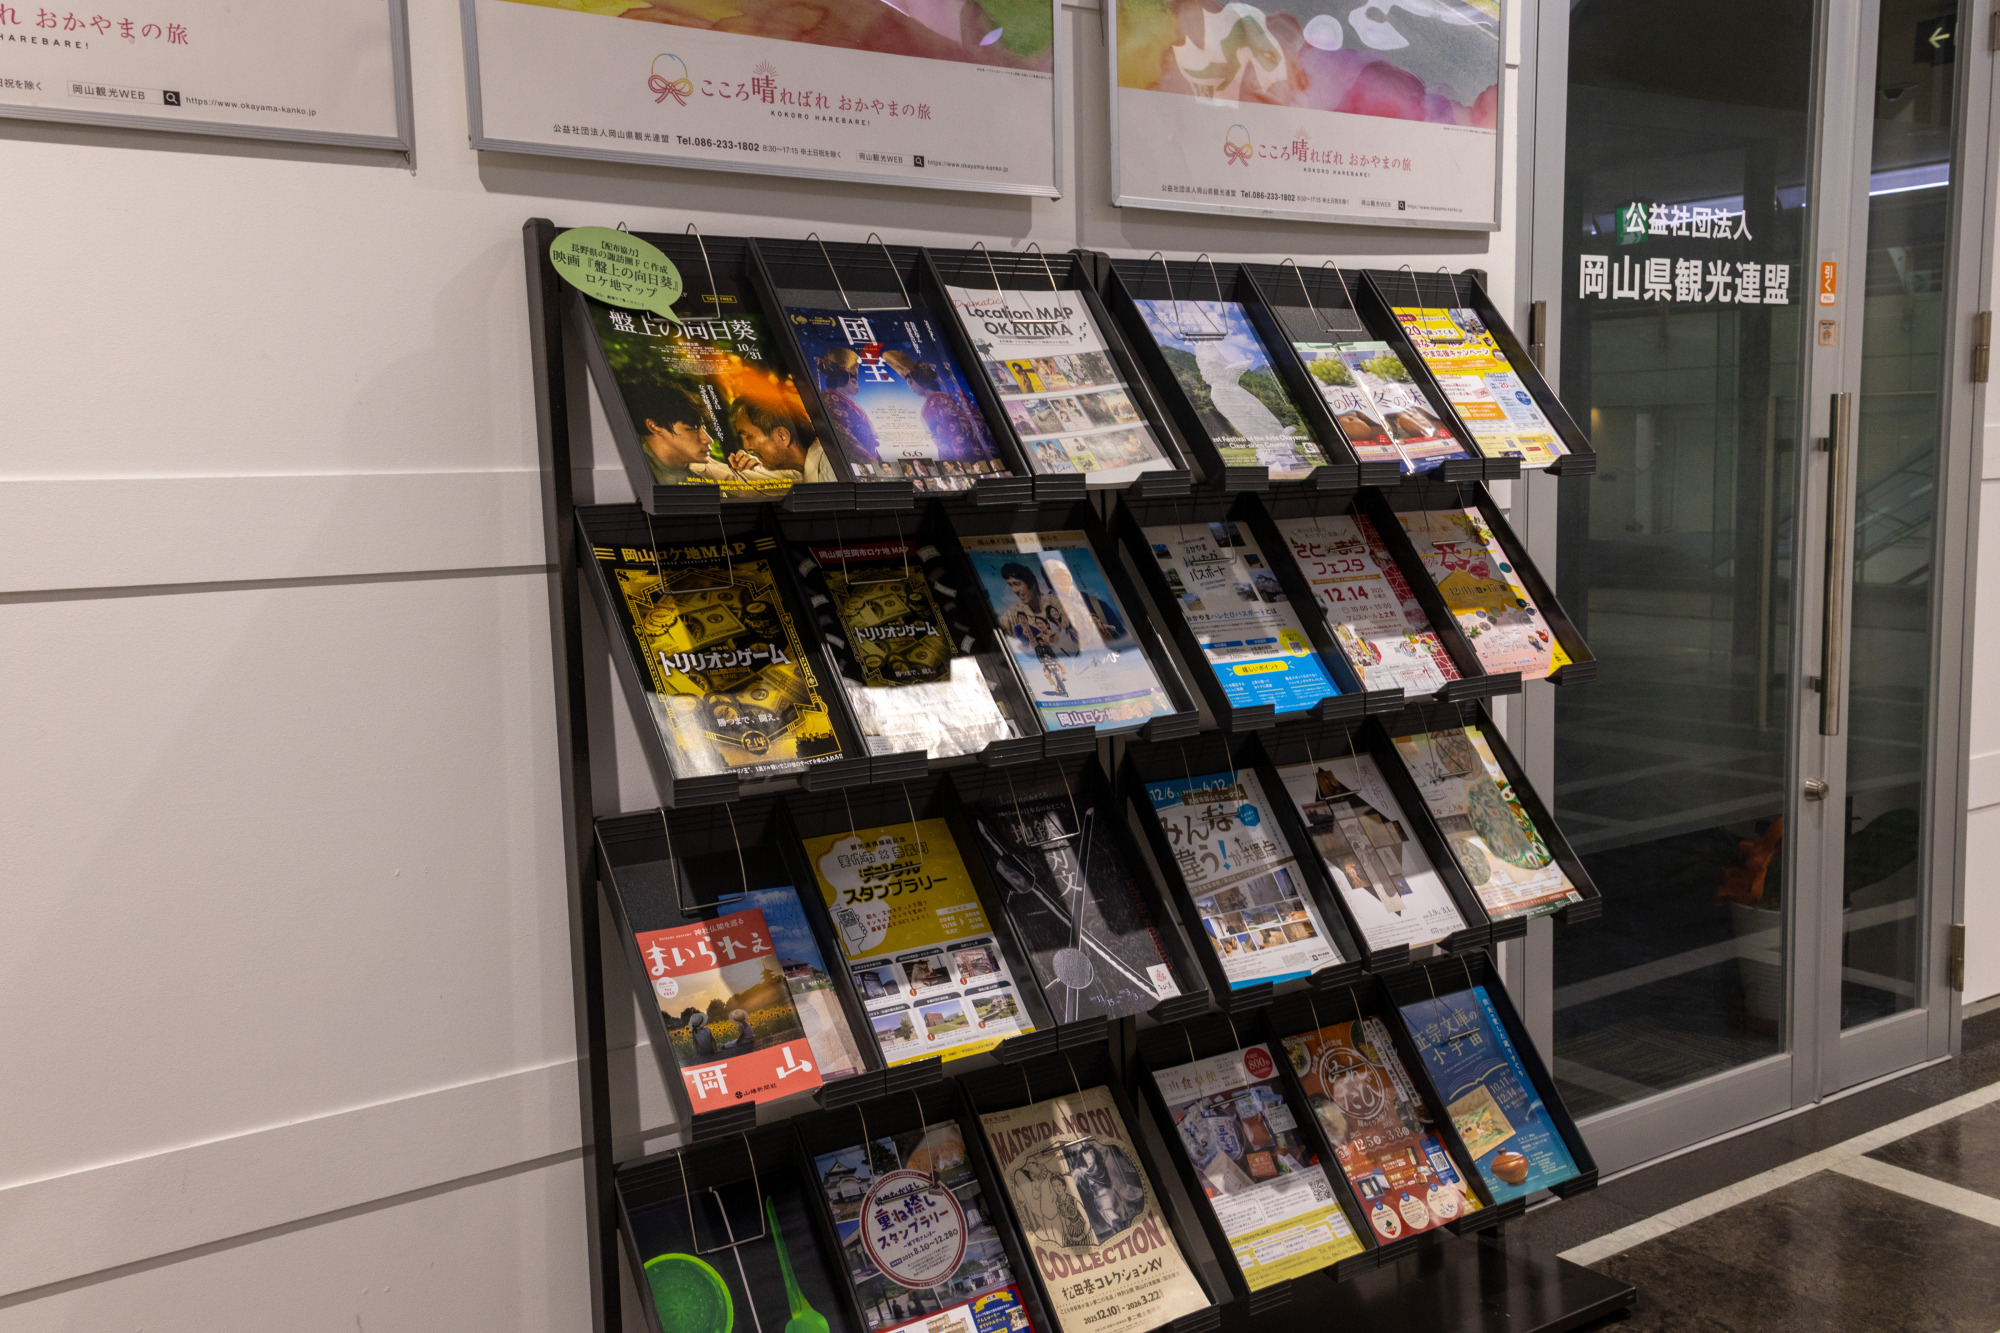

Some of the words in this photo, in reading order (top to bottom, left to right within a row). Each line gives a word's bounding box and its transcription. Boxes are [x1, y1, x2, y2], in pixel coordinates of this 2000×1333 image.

[35, 7, 189, 45] おかやまの旅
[72, 84, 146, 101] 岡山観光WEB
[186, 96, 317, 118] https://www.okayama-kanko.jp
[701, 75, 830, 109] こころ晴ればれ
[839, 95, 931, 120] おかやまの旅
[771, 110, 809, 120] KOKORO
[815, 114, 871, 126] HAREBARE!
[553, 124, 669, 143] 公益社団法人岡山県観光連盟
[676, 136, 760, 151] Tel.086-233-1802
[858, 152, 903, 164] 岡山観光WEB
[1258, 139, 1344, 165] こころ晴ればれ
[1349, 152, 1412, 171] おかやまの旅
[1333, 170, 1371, 178] HAREBARE!
[1161, 184, 1236, 198] 公益社団法人岡山県観光連盟
[1241, 190, 1296, 202] Tel.086-233-1802
[1361, 200, 1392, 208] 岡山観光WEB
[1626, 202, 1752, 241] 公益社団法人
[600, 240, 640, 258] 【配布協力】
[552, 250, 679, 292] 映画『盤上の向日葵』
[1579, 254, 1790, 305] 岡山県観光連盟
[1824, 265, 1833, 292] 引く
[586, 273, 658, 298] ロケ地マップ
[609, 310, 758, 341] 盤上の向日葵
[964, 304, 1033, 320] Location
[1037, 307, 1073, 320] MAP
[985, 321, 1074, 337] OKAYAMA
[837, 316, 896, 383] 国宝
[1327, 392, 1367, 410] の味
[1373, 388, 1427, 408] 冬の味
[621, 542, 746, 563] 岡山ロケ地MAP
[819, 547, 890, 559] 岡山県笠岡市ロケ地
[1189, 565, 1226, 582] パスポート
[1312, 558, 1366, 575] フェスタ
[1323, 585, 1369, 602] 12.14
[854, 622, 940, 643] トリリオンゲーム
[659, 643, 792, 676] トリリオンゲーム
[1057, 700, 1154, 727] 岡山ロケ地ガイド
[1149, 786, 1175, 802] 12/6
[1203, 779, 1228, 792] 4/12
[1159, 804, 1235, 846] みんな
[842, 875, 948, 906] スタンプラリー
[694, 918, 744, 936] 神社仏閣を巡る
[1413, 1007, 1478, 1052] 正宗文庫の
[684, 1063, 729, 1100] 岡
[775, 1046, 813, 1080] 山
[1490, 1077, 1510, 1094] 10.11
[1497, 1087, 1517, 1105] 12.14
[991, 1121, 1061, 1171] MATSUDA
[1062, 1106, 1123, 1141] MOTOI
[878, 1210, 949, 1249] スタンプラリー
[1035, 1210, 1167, 1282] COLLECTION
[1061, 1257, 1163, 1301] 松田基コレクションXV
[1127, 1290, 1160, 1310] 2026.3.22
